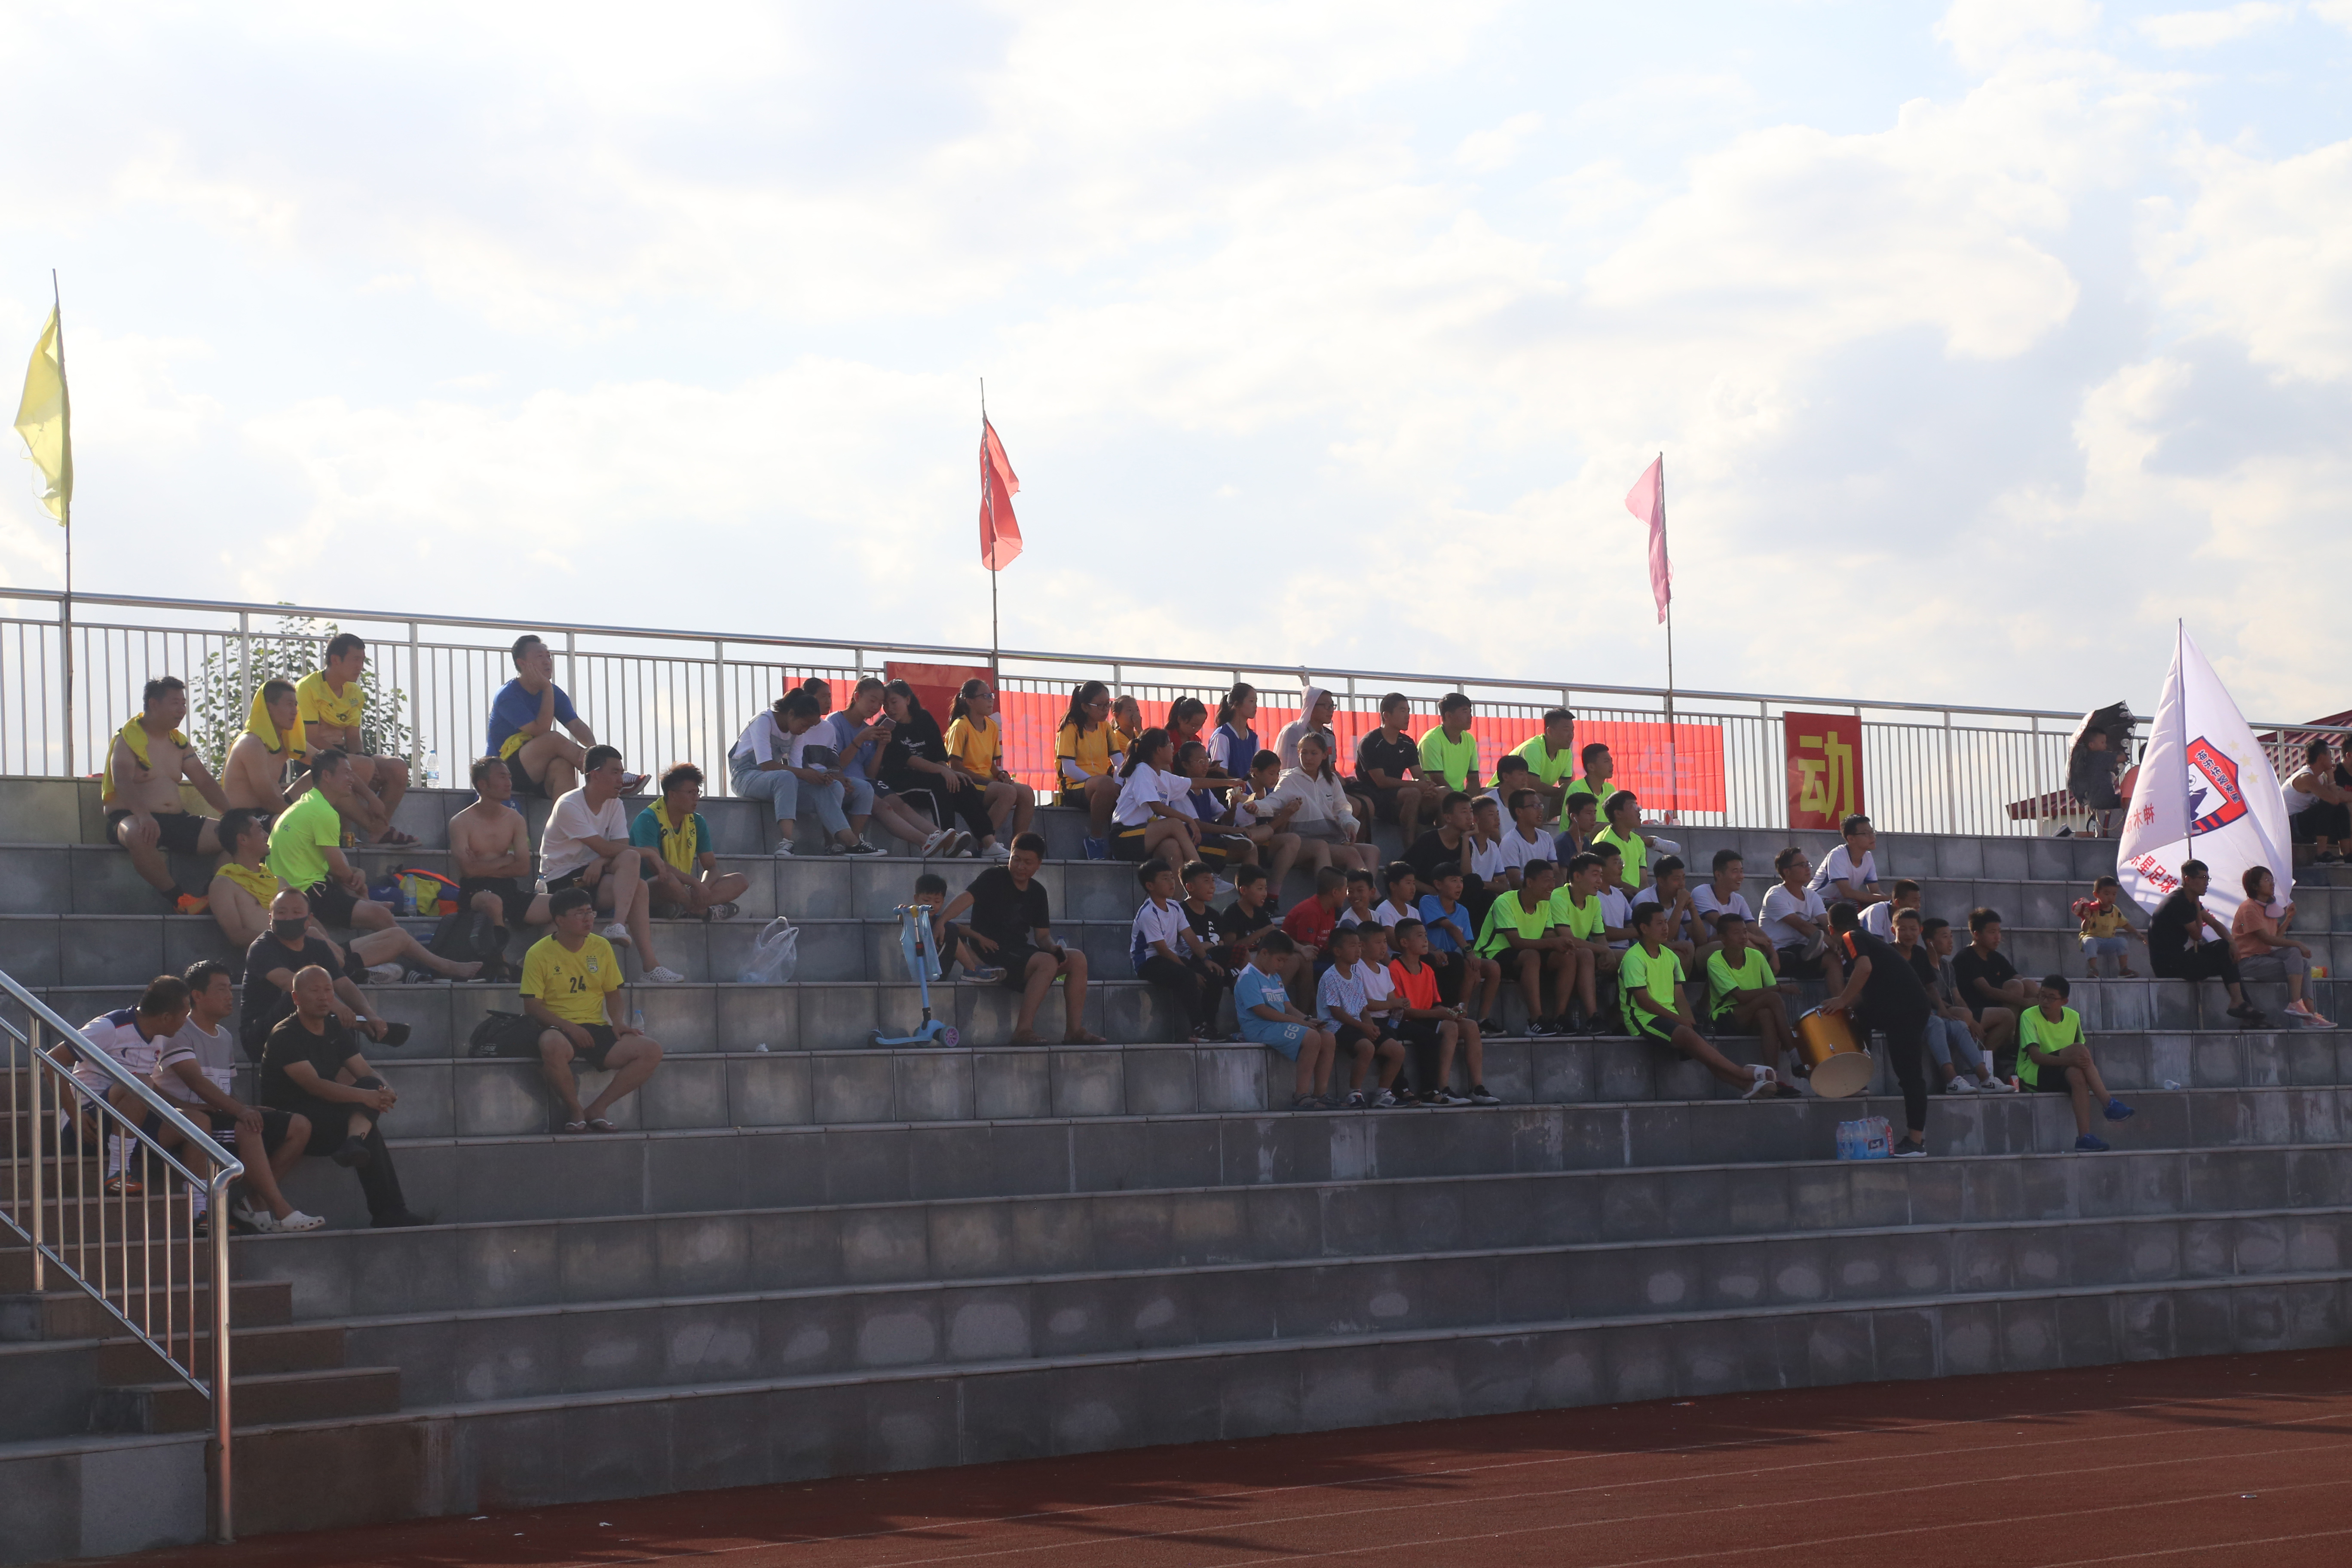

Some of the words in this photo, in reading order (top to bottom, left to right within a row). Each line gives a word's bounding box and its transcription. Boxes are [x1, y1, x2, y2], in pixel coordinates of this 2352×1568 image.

[1636, 743, 1697, 796] 生
[1798, 731, 1855, 823] 动
[570, 976, 586, 993] 24
